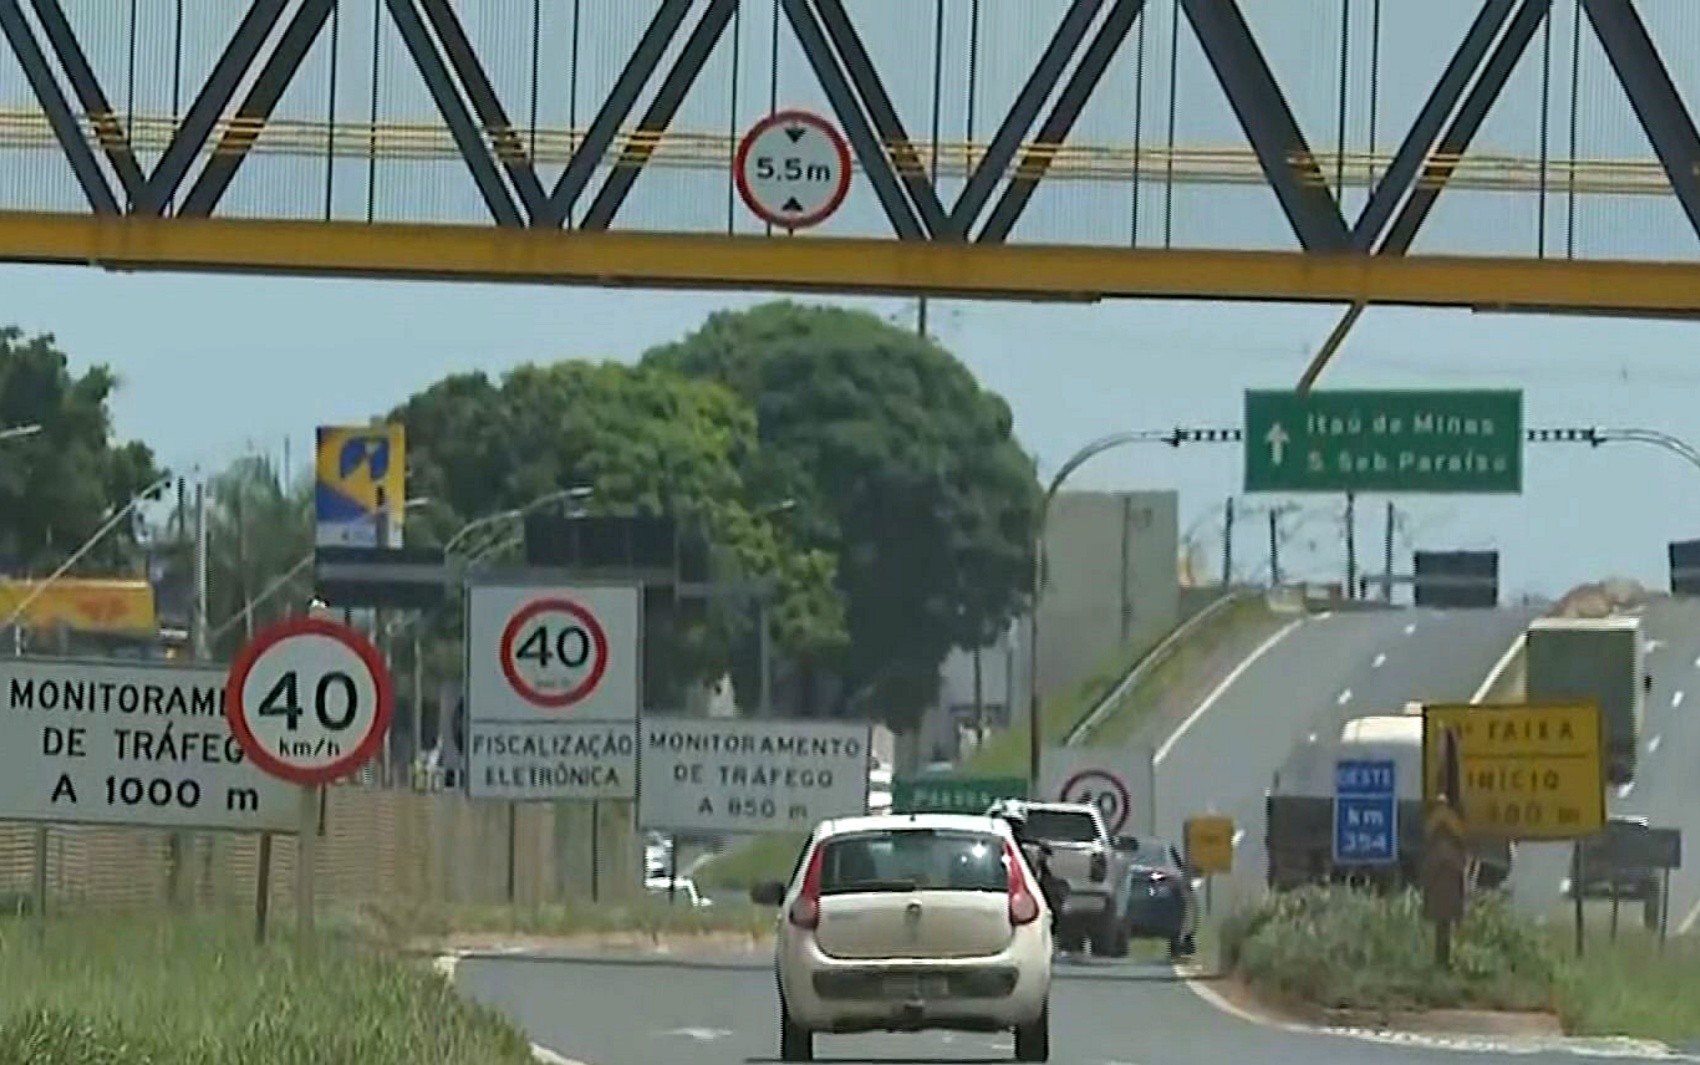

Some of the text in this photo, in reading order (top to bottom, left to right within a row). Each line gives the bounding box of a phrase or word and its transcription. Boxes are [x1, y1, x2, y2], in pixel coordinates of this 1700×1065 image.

[1373, 413, 1401, 434] de
[1414, 413, 1494, 435] Minas
[516, 626, 589, 668] 40
[259, 670, 357, 731] 40
[43, 727, 86, 757] DE
[114, 721, 244, 764] TRÁFEG
[279, 737, 340, 757] km/h
[650, 733, 860, 758] MONITORAMENTO
[485, 761, 619, 786] ELETRÔNICA
[674, 764, 833, 788] DE TRÁFEGO
[52, 772, 258, 811] A 1000 m
[698, 796, 713, 815] A
[1348, 804, 1383, 826] km
